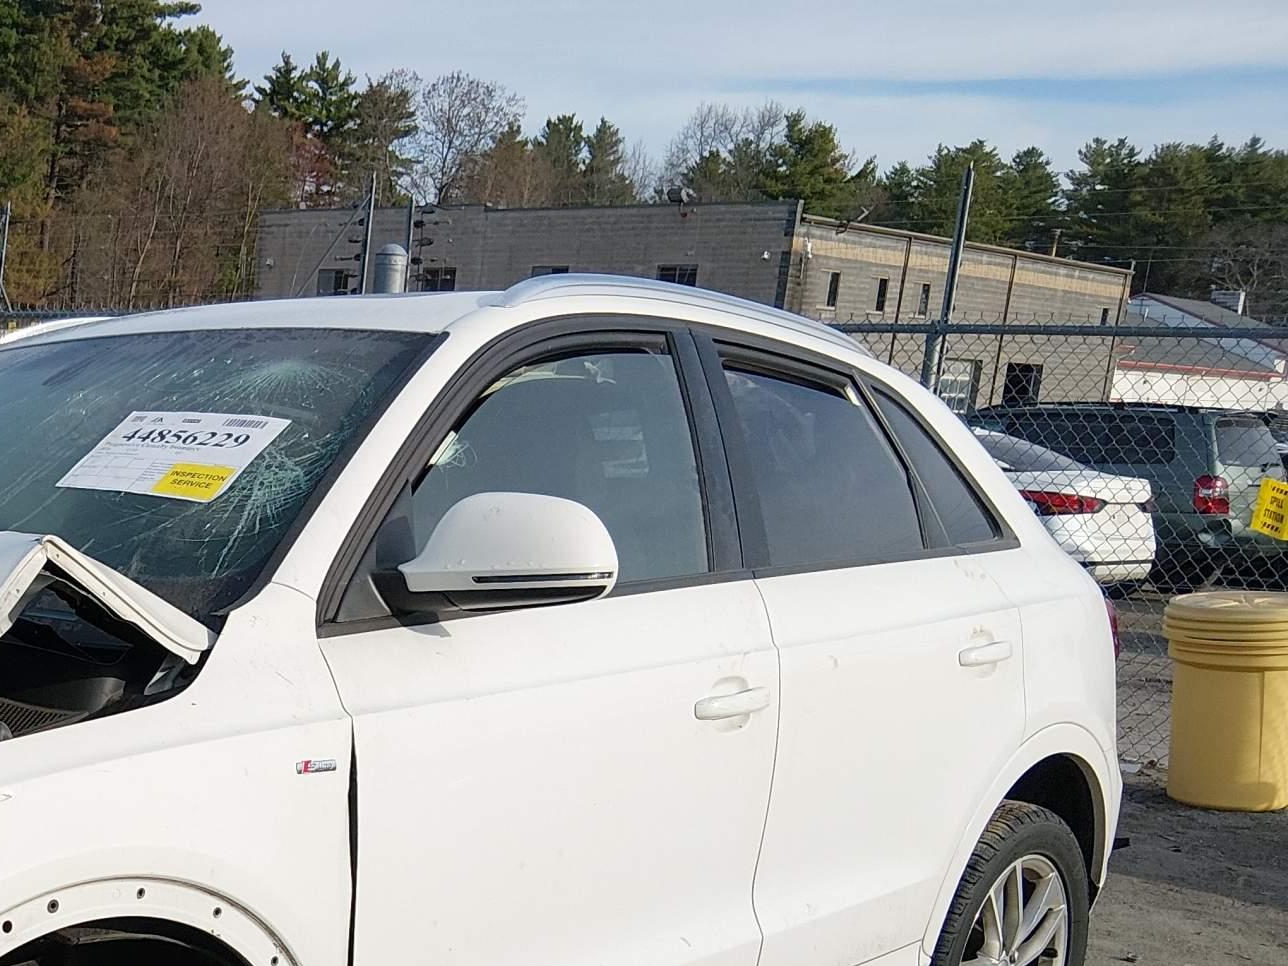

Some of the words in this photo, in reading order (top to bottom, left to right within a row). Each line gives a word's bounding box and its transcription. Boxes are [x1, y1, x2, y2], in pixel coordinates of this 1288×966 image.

[122, 427, 251, 449] 44856229
[170, 470, 227, 482] INSPECTION
[170, 478, 213, 489] SERVICE
